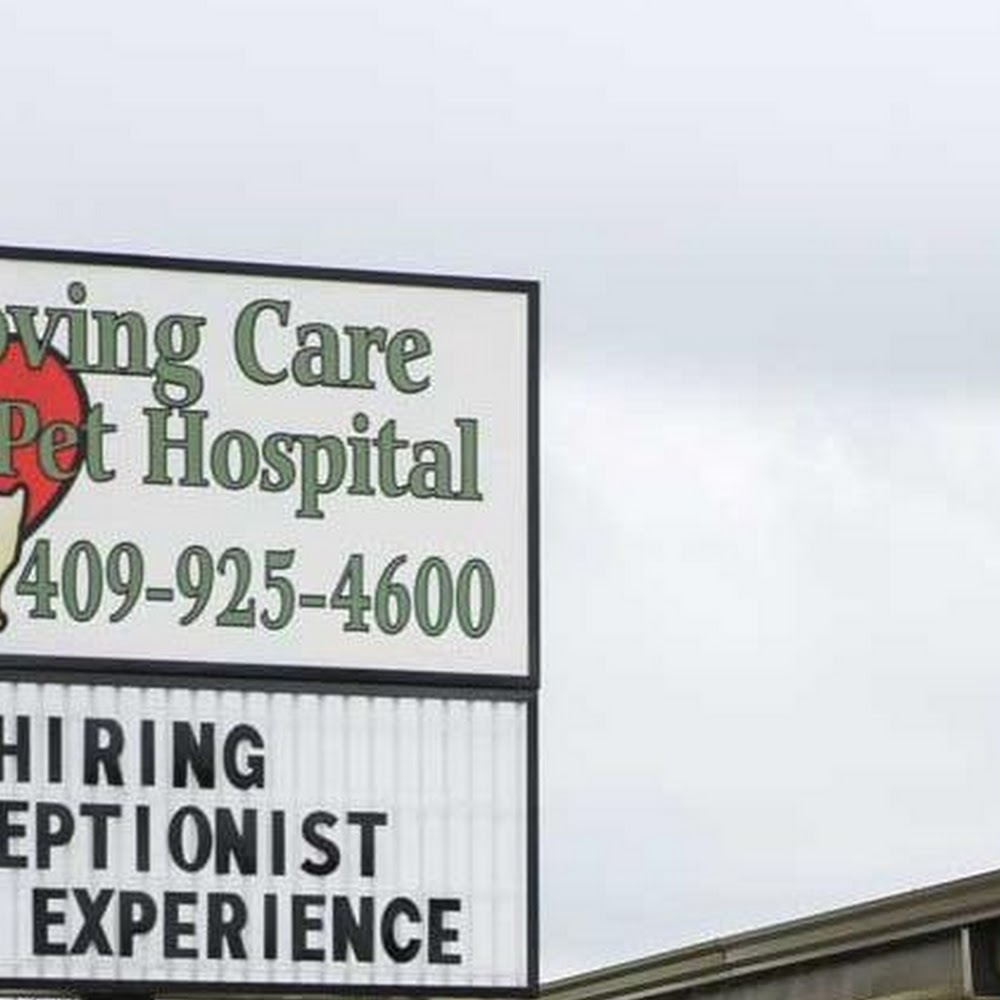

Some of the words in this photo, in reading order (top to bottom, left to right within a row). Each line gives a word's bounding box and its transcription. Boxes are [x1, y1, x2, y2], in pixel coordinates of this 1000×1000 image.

[0, 281, 207, 409] ving
[233, 298, 432, 394] Care
[0, 399, 117, 483] Pet
[142, 407, 483, 520] Hospital
[16, 538, 497, 639] 409-925-4600
[0, 714, 266, 790] HIRING
[0, 800, 388, 877] EPTIONIST
[32, 887, 463, 965] EXPERIENCE
